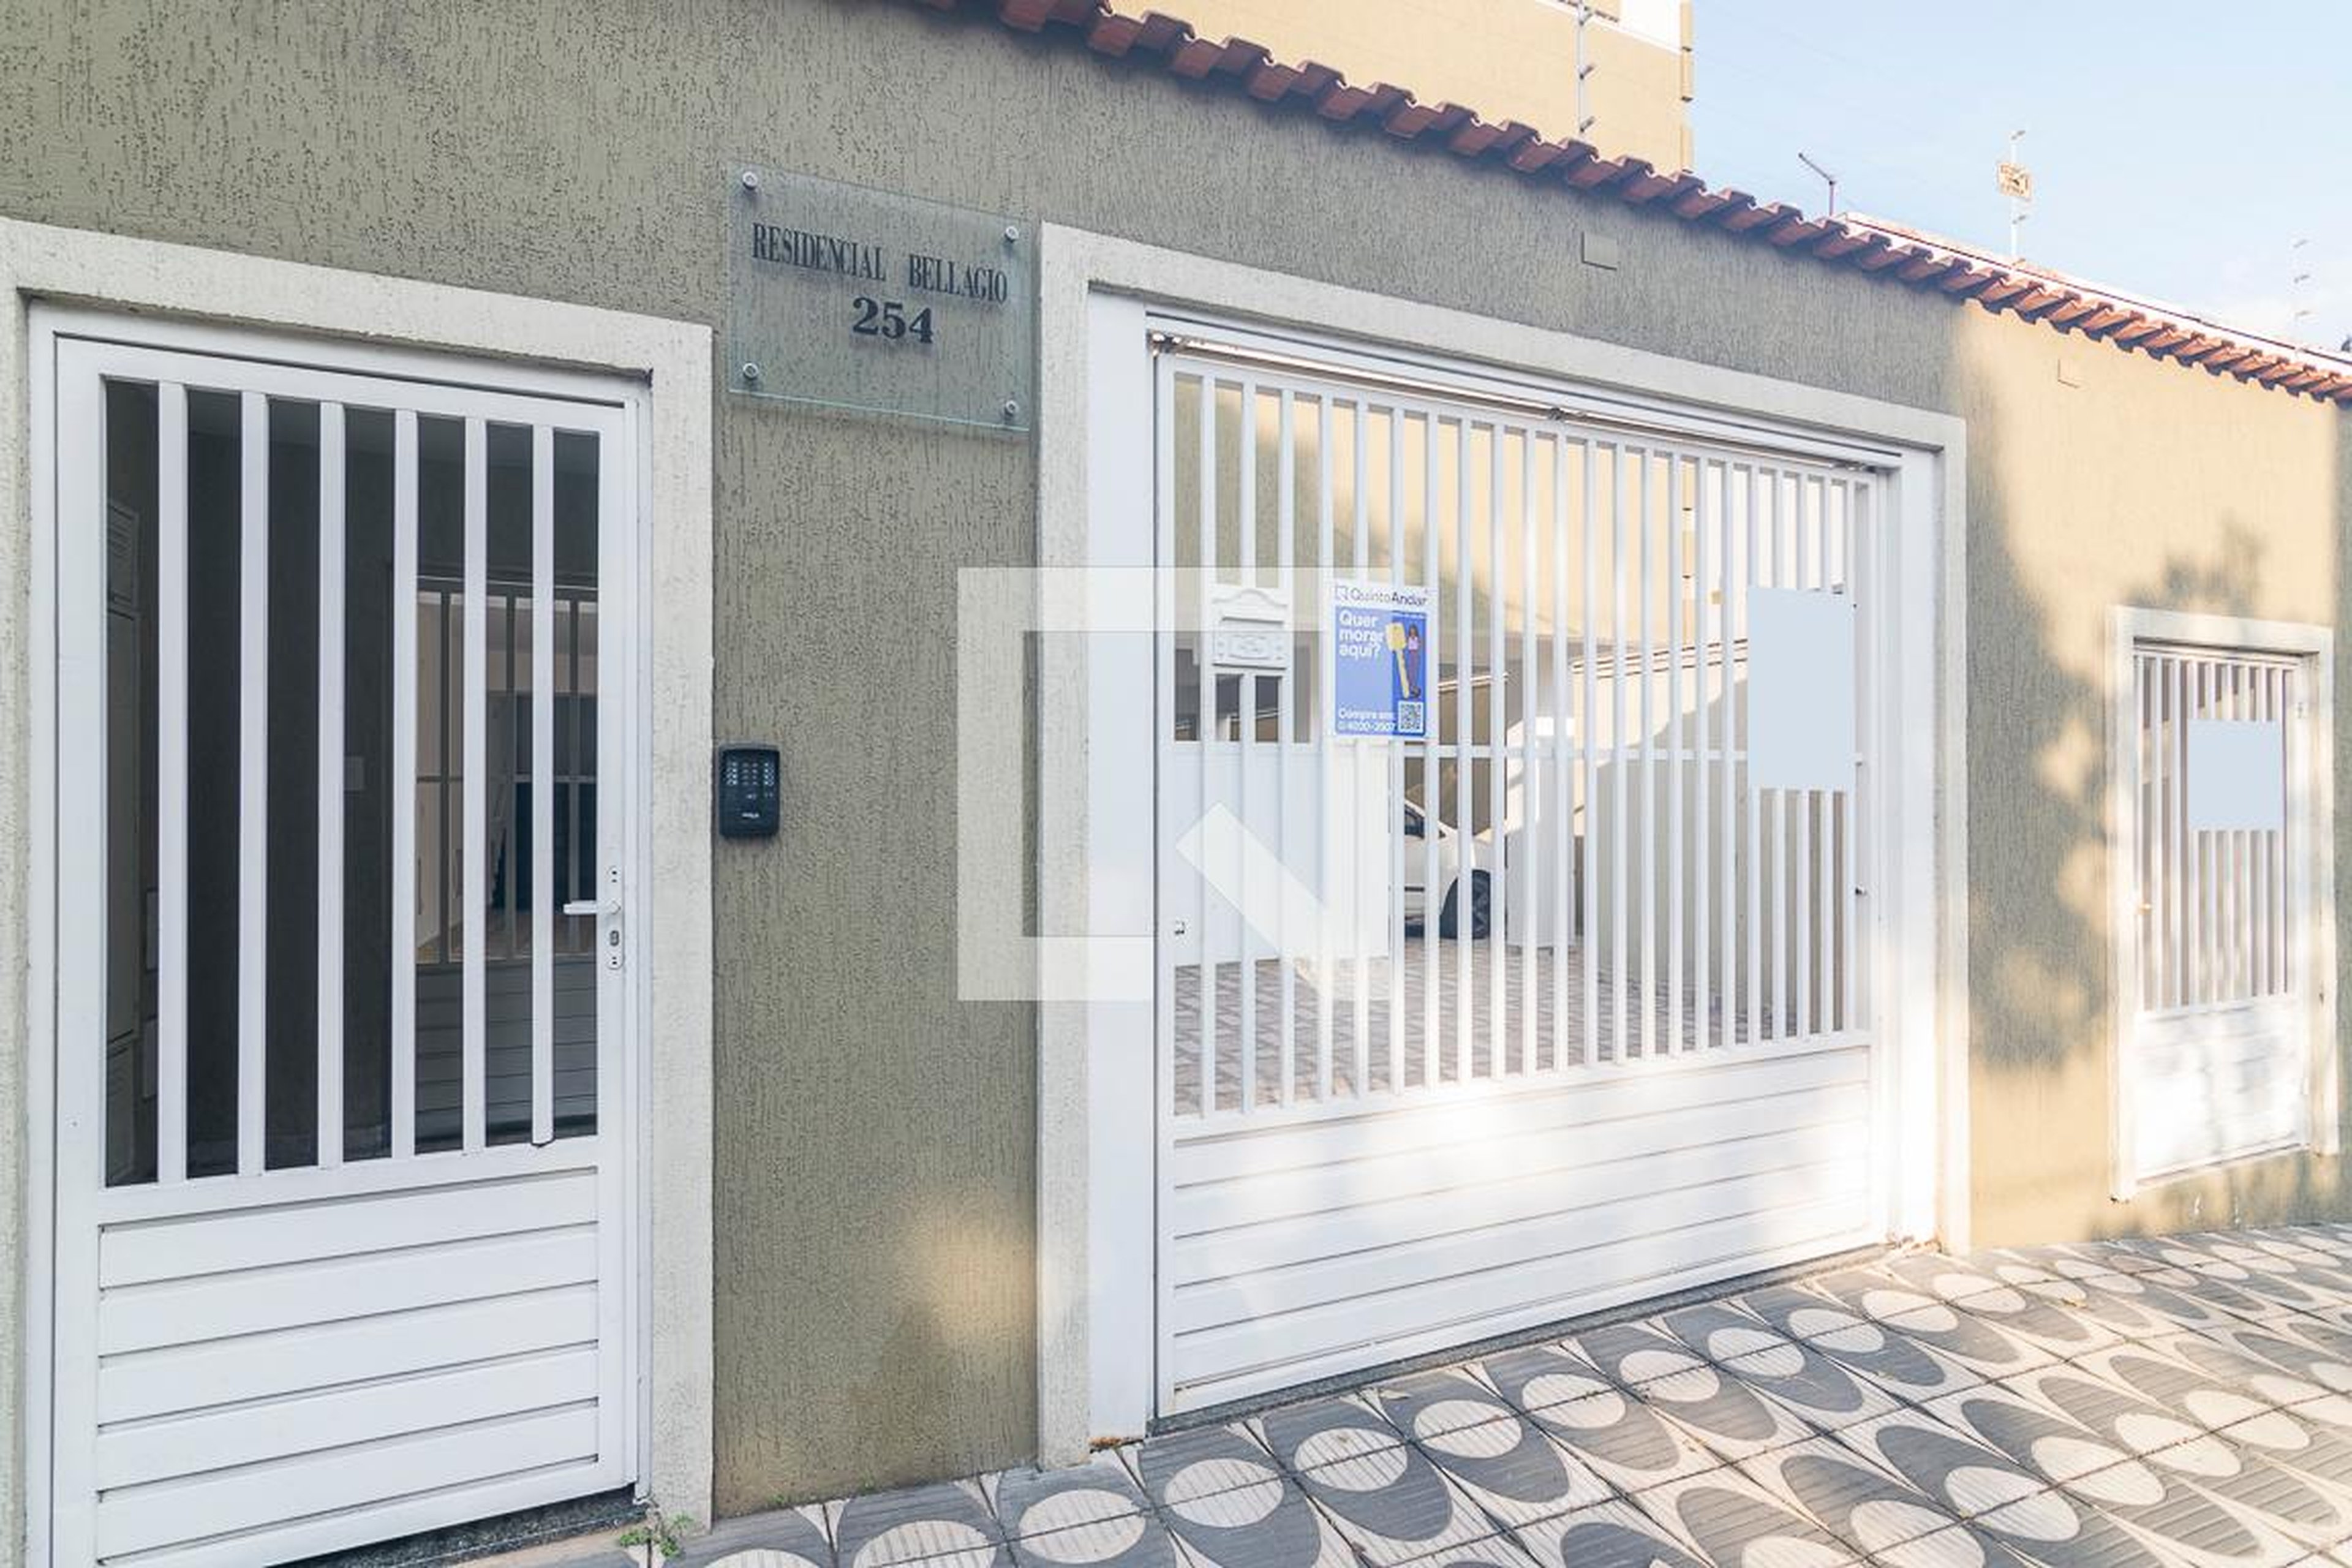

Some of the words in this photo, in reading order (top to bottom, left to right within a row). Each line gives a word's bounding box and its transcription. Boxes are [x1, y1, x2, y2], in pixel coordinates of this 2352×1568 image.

[752, 222, 886, 282] RESIDENCIAL
[909, 254, 1008, 304] BELLAGIO
[852, 296, 933, 344] 254
[1349, 587, 1428, 606] QuintoAndar
[1338, 609, 1379, 628] Quer
